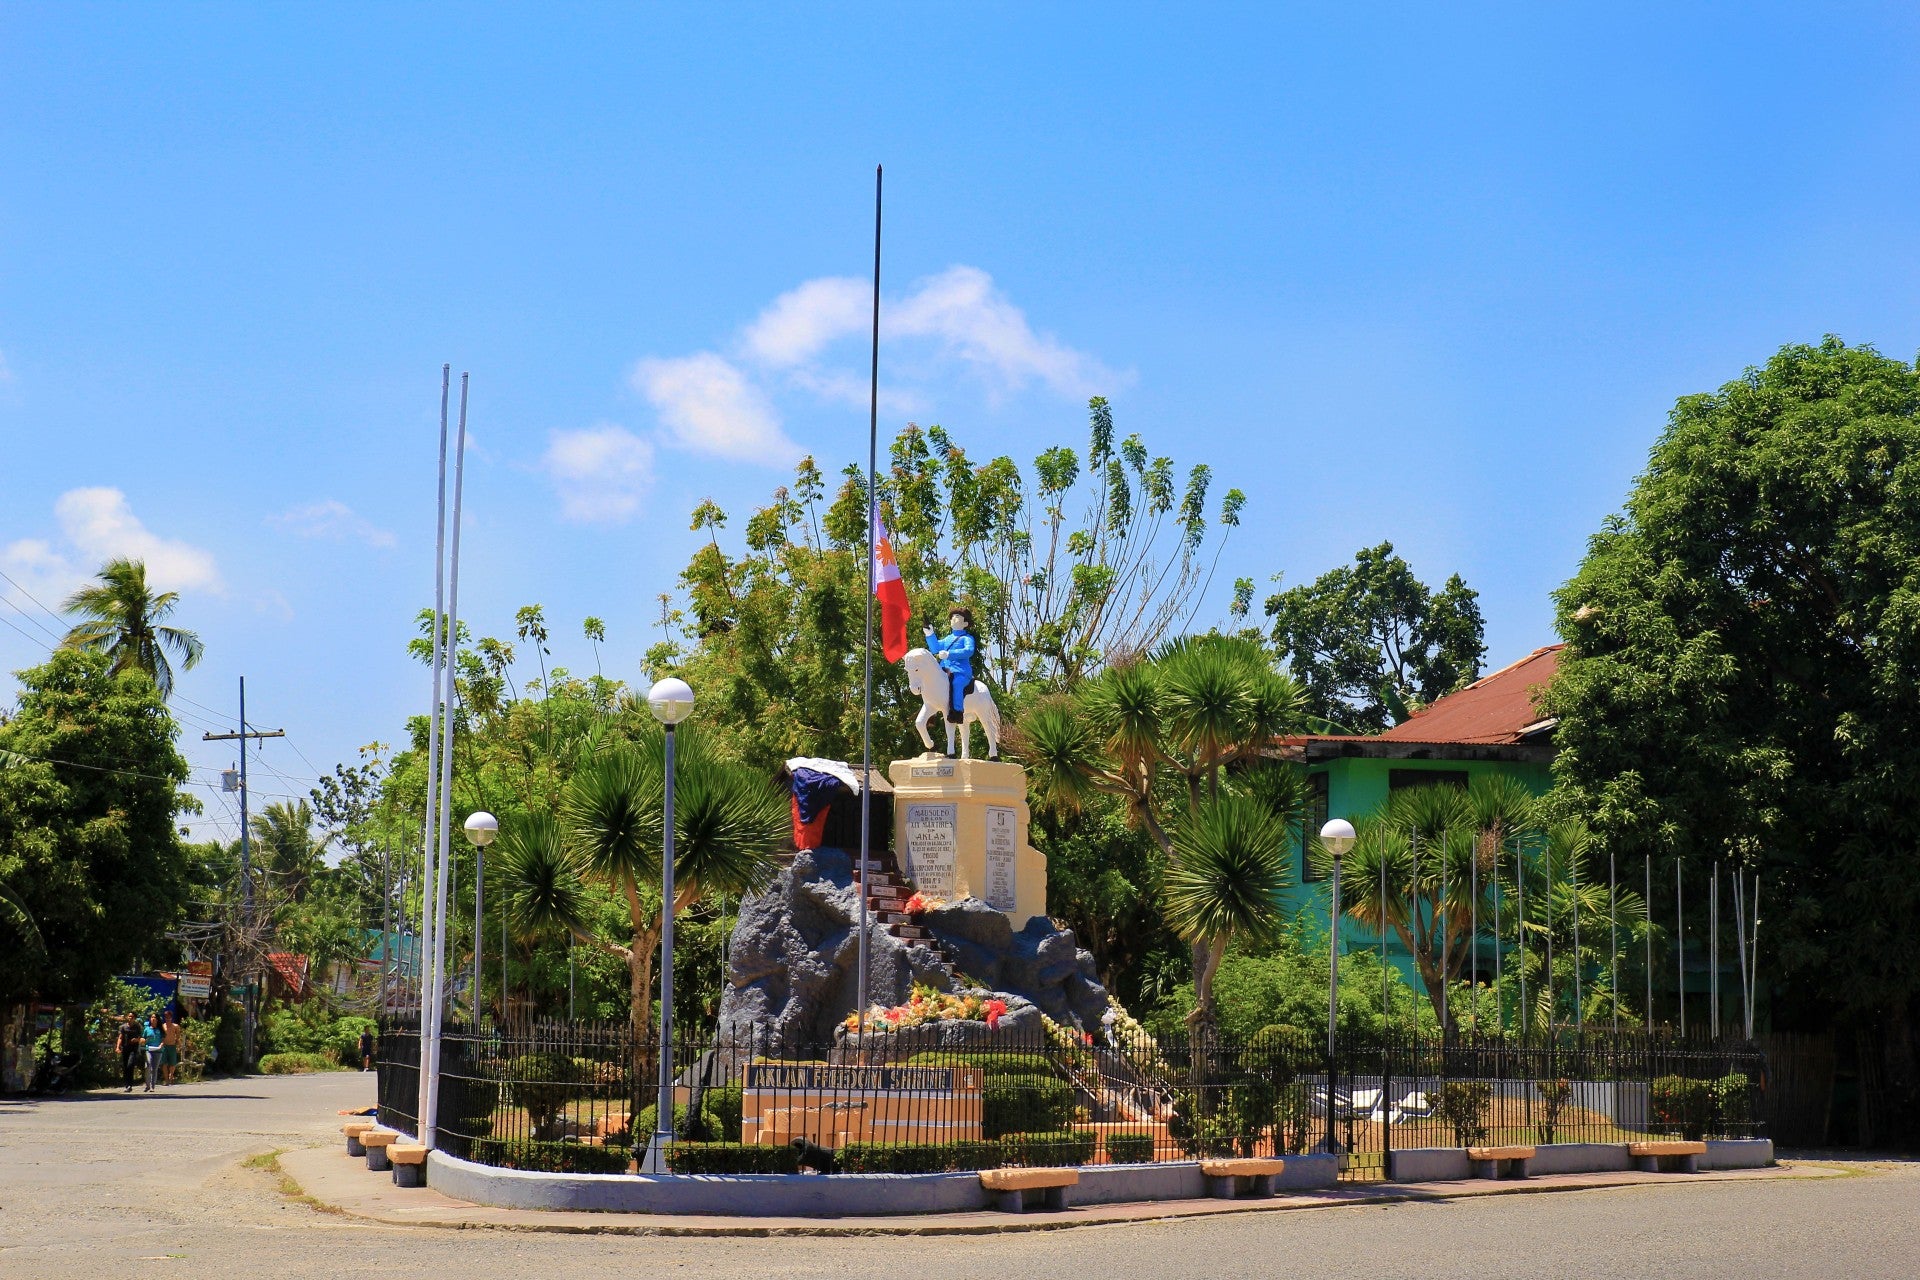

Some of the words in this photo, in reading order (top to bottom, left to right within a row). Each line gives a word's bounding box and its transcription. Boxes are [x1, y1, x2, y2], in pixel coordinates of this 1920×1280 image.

[914, 809, 950, 817] MAUSOLEO
[915, 833, 946, 841] AKLAN
[754, 1067, 809, 1088] AKLAN
[813, 1068, 882, 1089] FREEDOM
[890, 1069, 946, 1090] SHRINE
